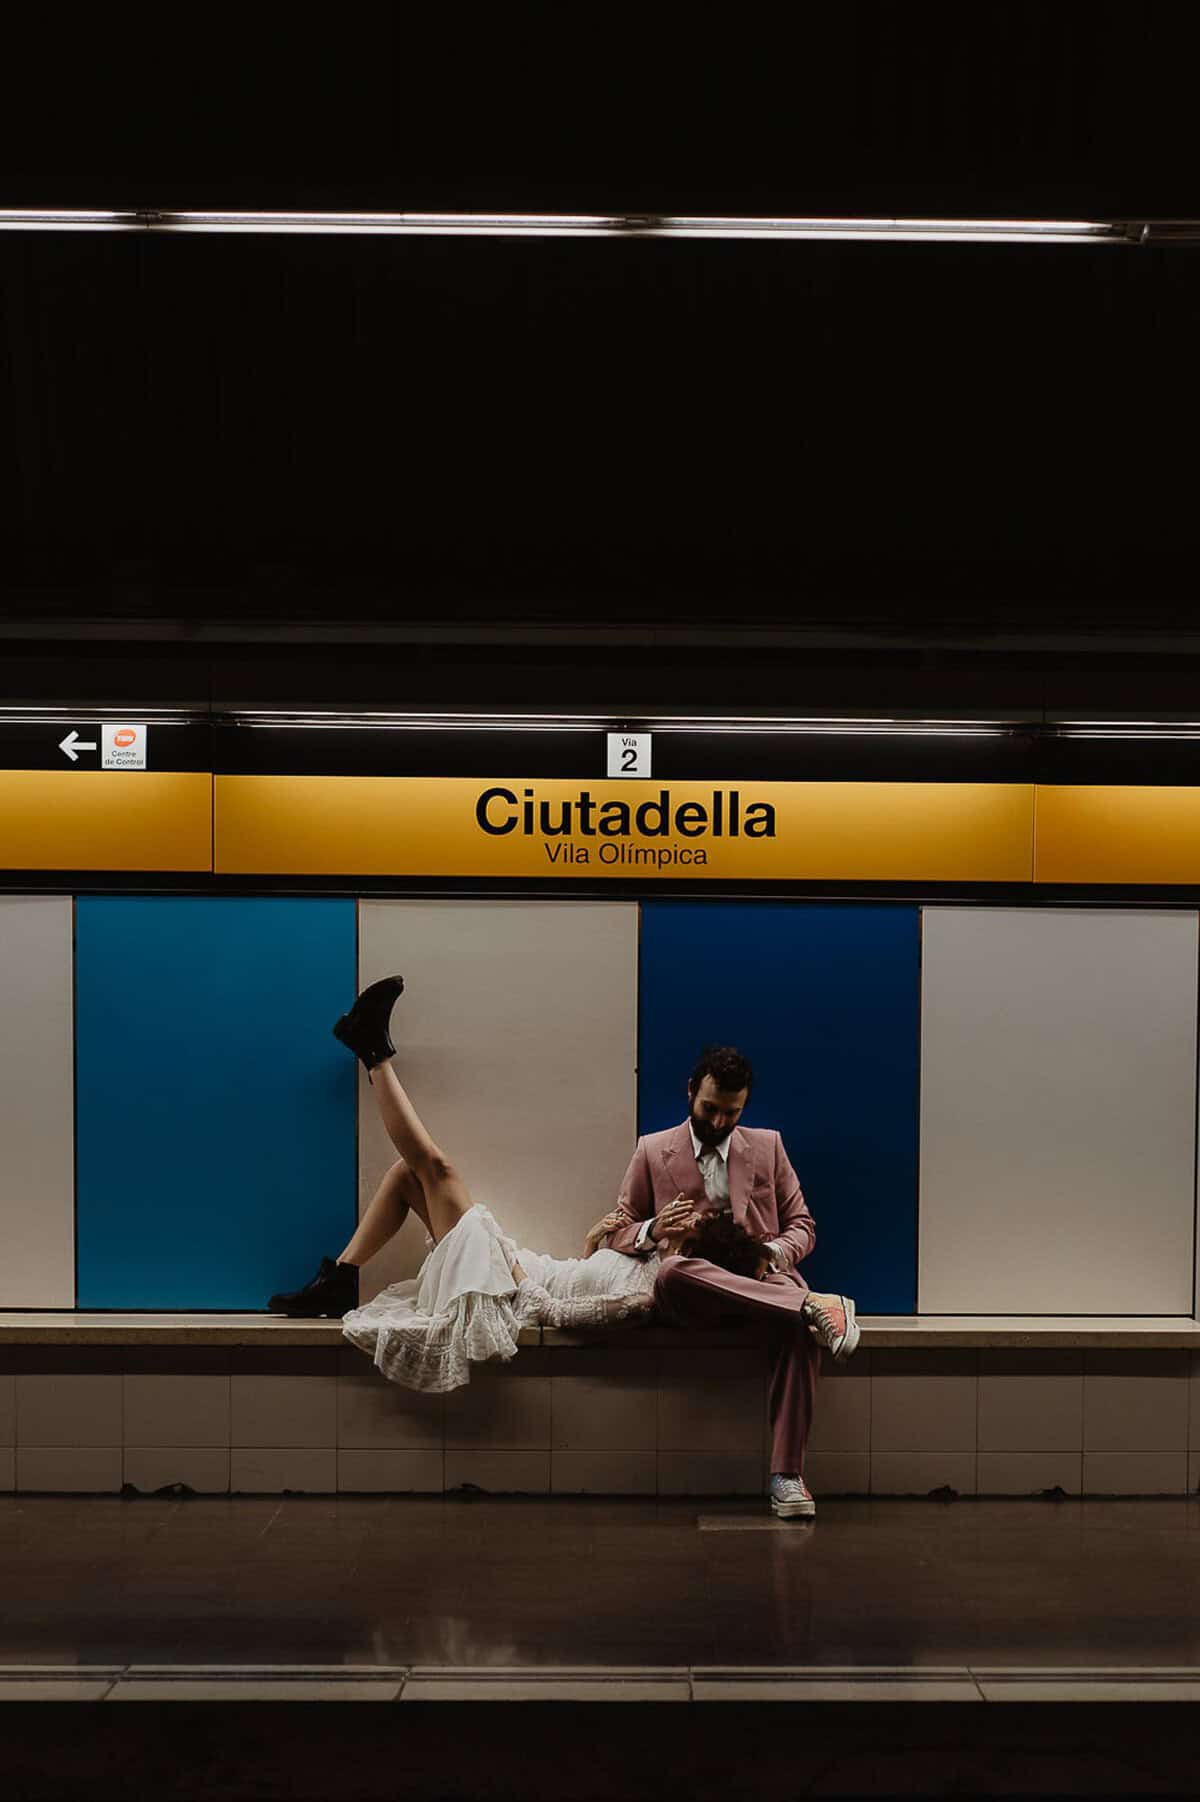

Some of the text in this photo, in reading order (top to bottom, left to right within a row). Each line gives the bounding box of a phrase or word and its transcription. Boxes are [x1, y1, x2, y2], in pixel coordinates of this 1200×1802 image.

[621, 749, 637, 771] 2
[475, 787, 776, 838] Ciutadella
[544, 842, 708, 869] Vila Olímpica
